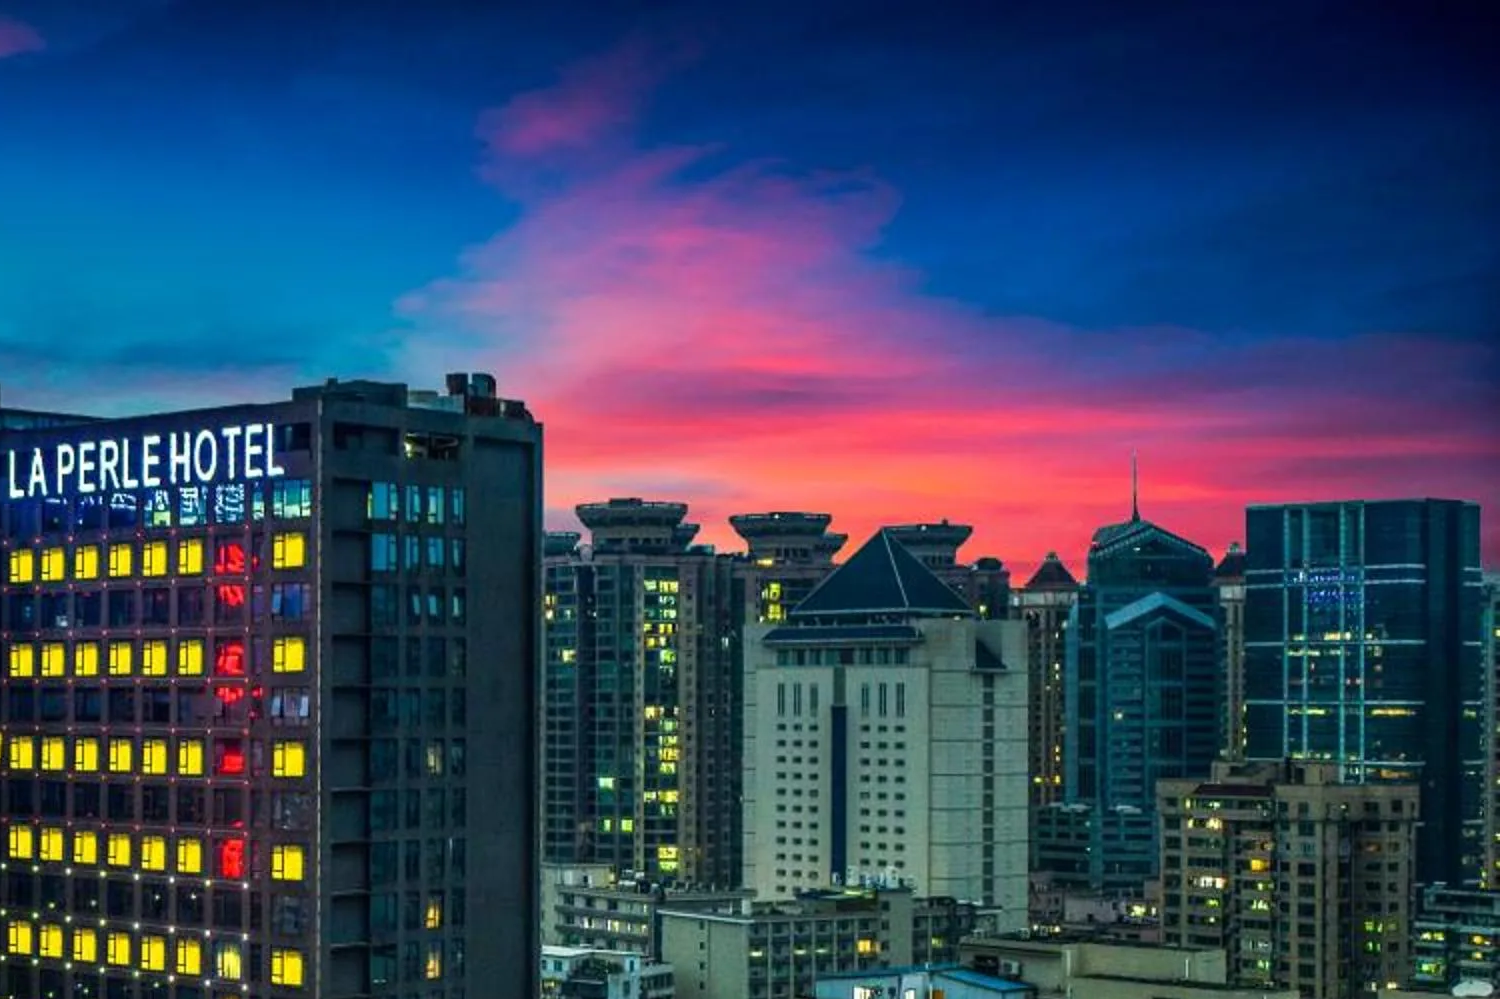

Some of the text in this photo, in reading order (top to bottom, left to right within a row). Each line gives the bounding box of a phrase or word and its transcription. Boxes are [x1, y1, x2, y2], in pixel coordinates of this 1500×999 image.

[8, 422, 286, 500] LA PERLE HOTEL
